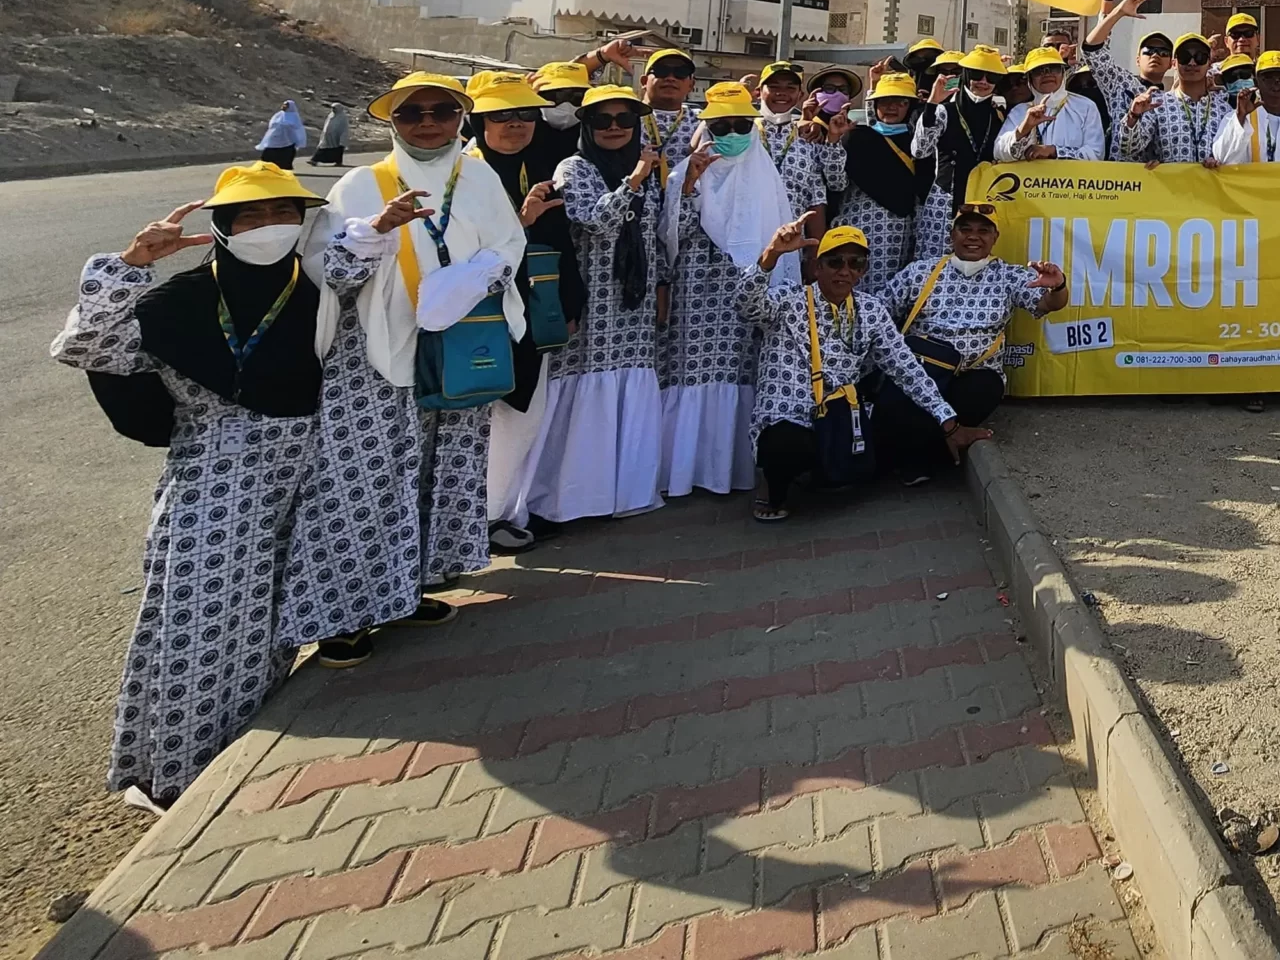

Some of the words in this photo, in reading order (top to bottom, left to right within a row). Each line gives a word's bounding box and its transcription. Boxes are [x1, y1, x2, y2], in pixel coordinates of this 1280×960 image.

[1023, 178, 1074, 189] CAHAYA
[1078, 179, 1141, 192] RAUDHAH
[1027, 217, 1259, 309] UMROH
[1067, 324, 1092, 347] BIS
[1098, 322, 1107, 343] 2
[1219, 323, 1241, 338] 22
[1136, 355, 1202, 364] 081-222-700-300
